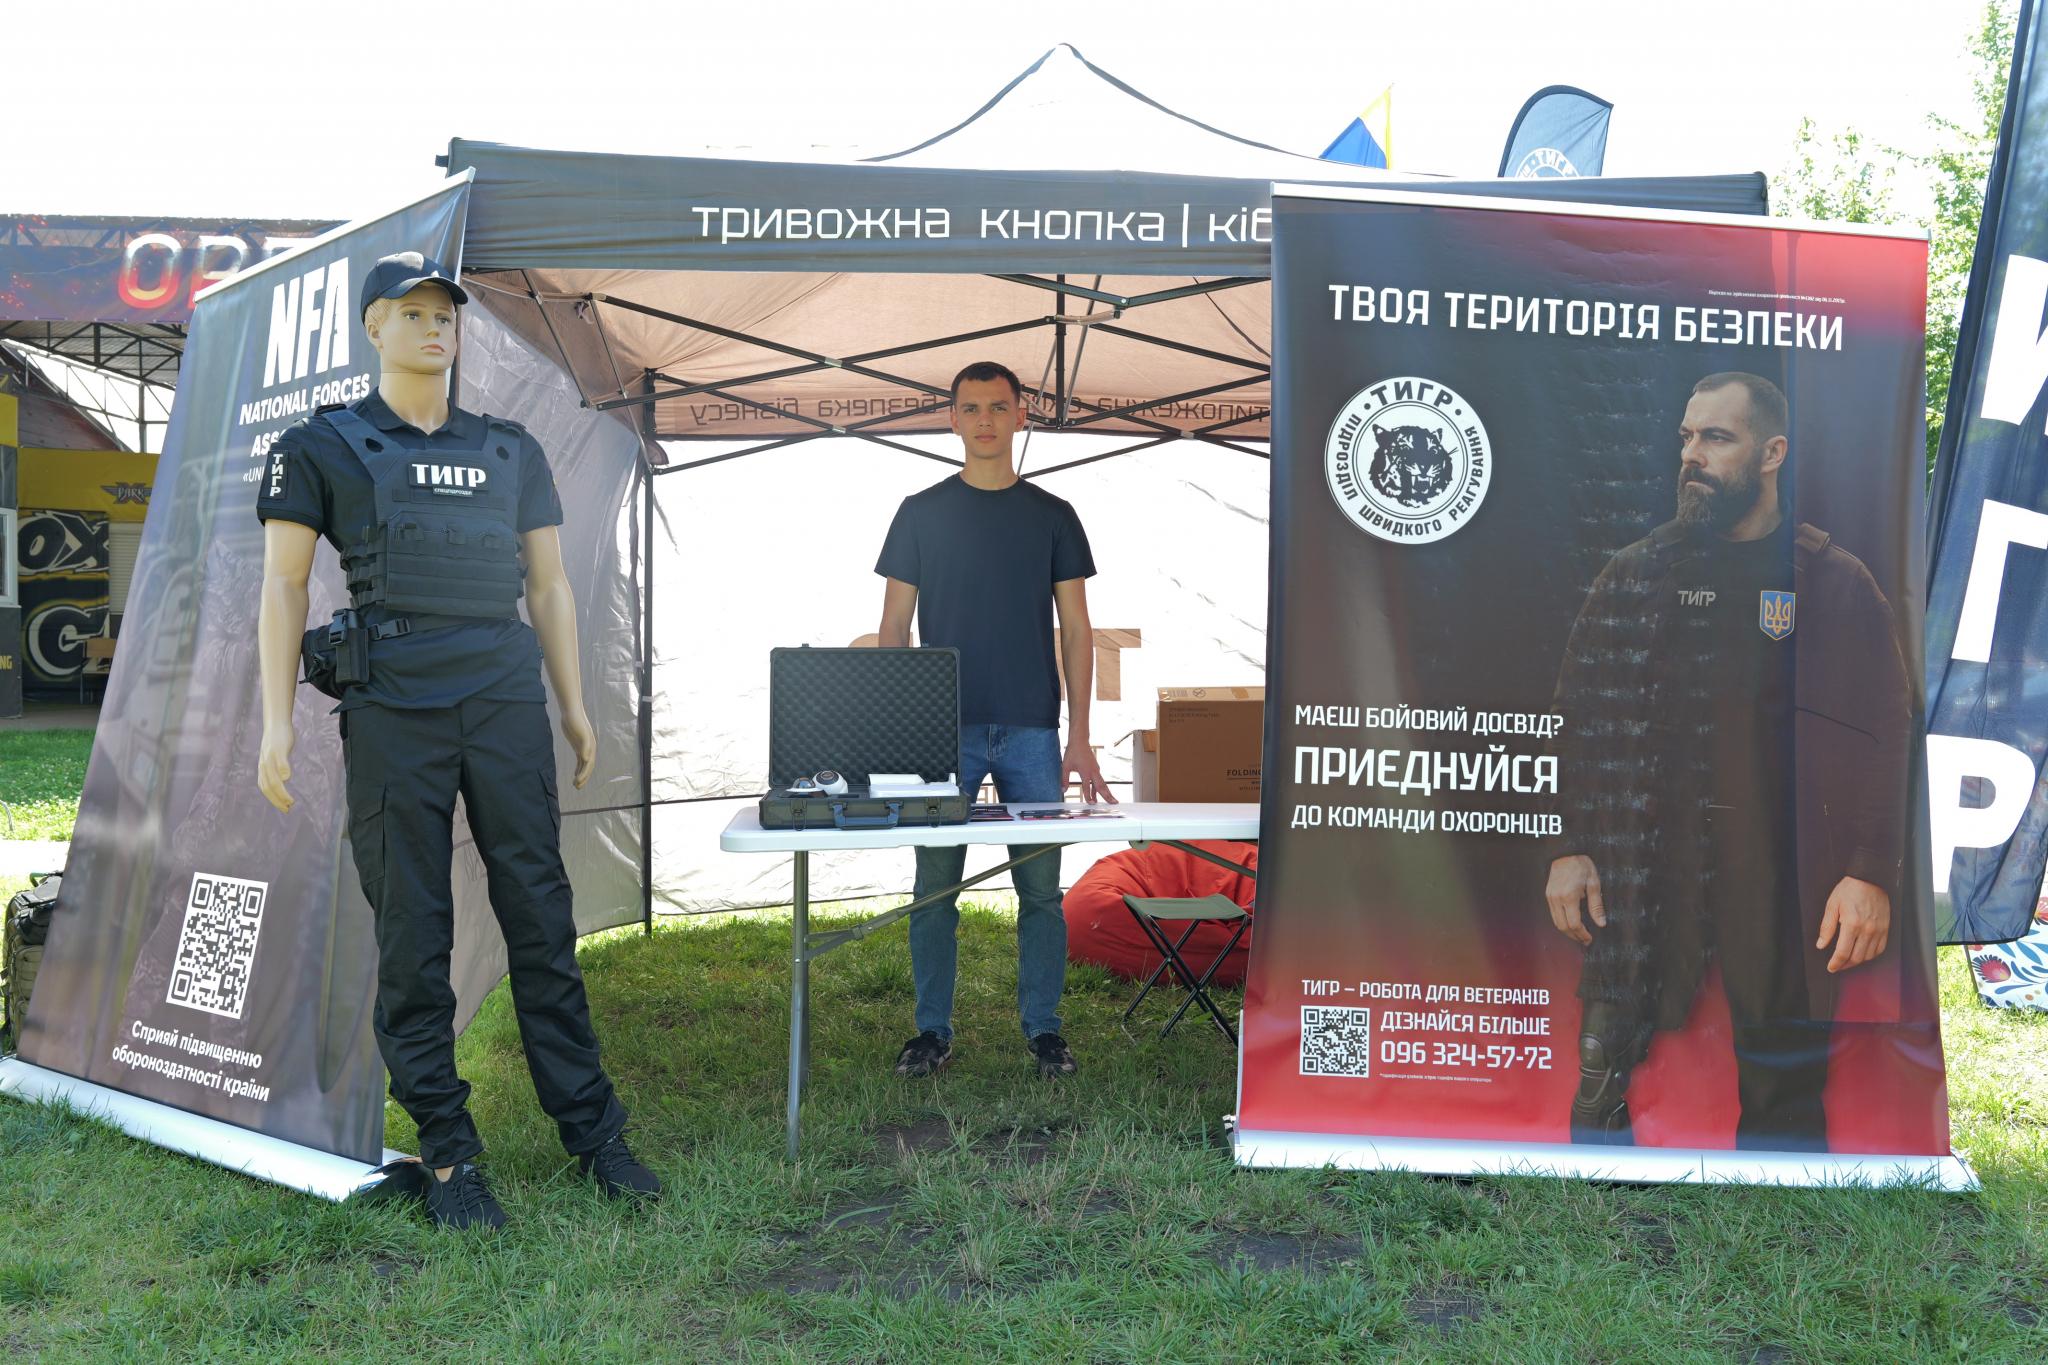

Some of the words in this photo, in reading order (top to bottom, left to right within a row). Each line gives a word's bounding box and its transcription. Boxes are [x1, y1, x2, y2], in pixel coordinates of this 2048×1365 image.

[692, 207, 950, 245] тривожна
[980, 209, 1165, 242] кнопка
[263, 257, 350, 389] NFA
[1328, 284, 1430, 326] ТВОЯ
[1445, 291, 1660, 340] ТЕРИТОРІЯ
[1675, 307, 1844, 351] БЕЗПЕКИ
[239, 389, 309, 426] NATIONAL
[311, 373, 370, 409] FORCES
[1370, 381, 1453, 408] ТИГР
[269, 453, 284, 497] ТИГР
[412, 463, 487, 488] ТИГР
[1335, 413, 1362, 501] ПІДРОЗДІЛ
[1358, 504, 1443, 537] ШВИДКОГО
[1448, 425, 1484, 522] РЕАГУВАННЯ
[1677, 590, 1717, 607] ТИГР
[1295, 704, 1360, 728] МАЄШ
[1365, 703, 1468, 732] БОЙОВИЙ
[1472, 711, 1564, 739] ДОСВІД?
[1294, 744, 1558, 797] ПРИЄДНУЙСЯ
[1291, 804, 1322, 830] ДО
[1328, 805, 1435, 834] КОМАНДИ
[1441, 810, 1562, 838] ОХОРОНЦІВ
[1301, 979, 1340, 996] ТИГР
[1359, 981, 1422, 1000] РОБОТА
[1425, 984, 1460, 1004] ДЛЯ
[1464, 986, 1550, 1005] ВЕТЕРАНІВ
[1380, 1008, 1474, 1033] ДІЗНАЙСЯ
[1478, 1015, 1551, 1036] БІЛЬШЕ
[131, 1019, 180, 1049] Сприяй
[179, 1032, 263, 1070] підвищенню
[1380, 1040, 1426, 1064] 096
[1432, 1042, 1552, 1070] 324-57-72
[111, 1044, 223, 1090] обороноздатності
[222, 1076, 271, 1102] країни
